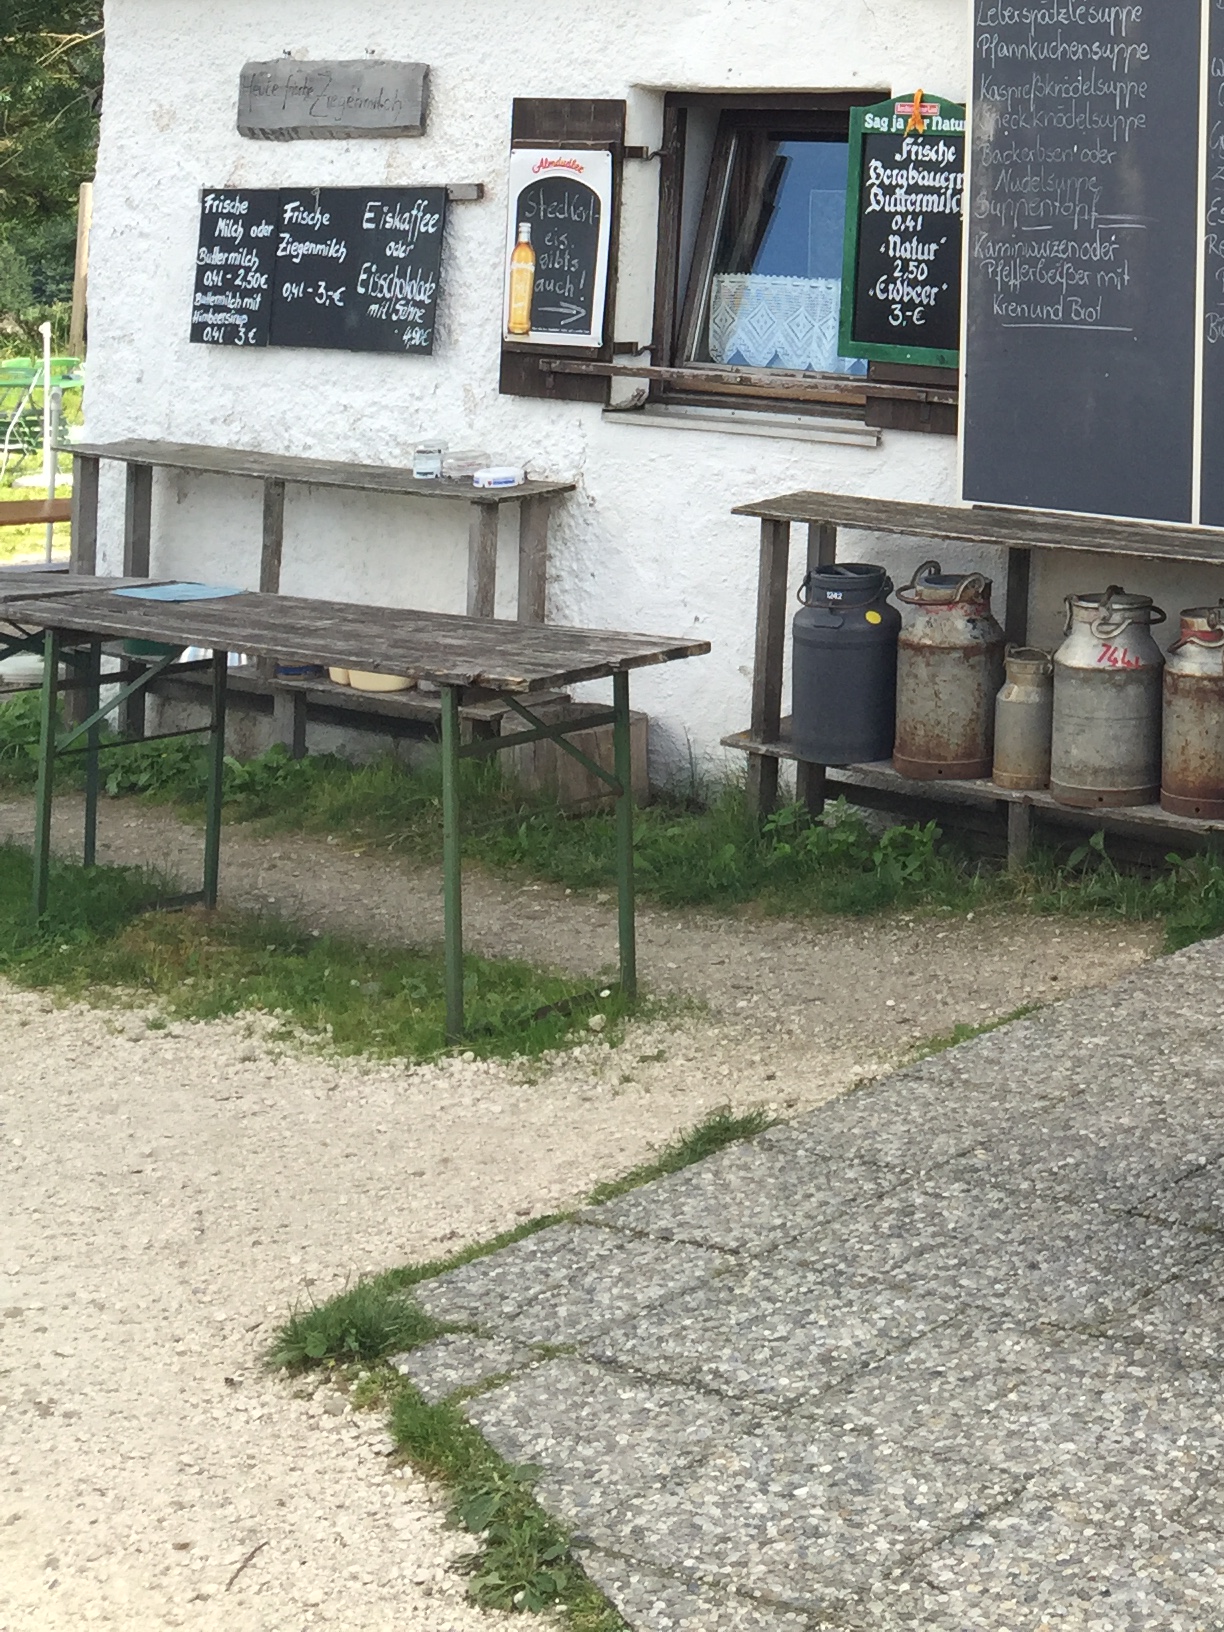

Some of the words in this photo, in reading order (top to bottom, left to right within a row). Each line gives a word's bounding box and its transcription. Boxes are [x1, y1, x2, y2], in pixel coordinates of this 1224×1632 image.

[977, 29, 1150, 73] Pfannkuchensuppe
[864, 113, 888, 132] Sag
[891, 115, 904, 132] ja
[894, 137, 956, 168] Frische
[1080, 138, 1117, 164] oder
[995, 165, 1101, 207] Nudelsuppe
[204, 193, 249, 216] Frische
[283, 200, 331, 230] Frische
[215, 218, 244, 245] Milch
[250, 220, 274, 238] oder
[362, 199, 440, 242] Eiskaffee
[196, 246, 259, 271] Buttermilch
[276, 233, 347, 264] Ziegenmilch
[385, 240, 415, 259] oder
[974, 232, 1079, 259] Kaminwurzen
[1080, 229, 1119, 261] oder
[538, 250, 580, 270] gibts
[893, 261, 928, 282] 2,50
[234, 269, 268, 289] 2,50€
[356, 262, 436, 305] Eisschokolade
[534, 271, 587, 301] auch!
[980, 258, 1090, 294] Pfefferbeißer
[1097, 260, 1130, 290] mit
[243, 294, 262, 312] mit
[367, 301, 387, 320] mit
[391, 299, 427, 324] Sahne
[993, 294, 1027, 317] Kren
[1029, 295, 1063, 321] und
[1067, 296, 1102, 322] Brot
[234, 326, 246, 345] 3
